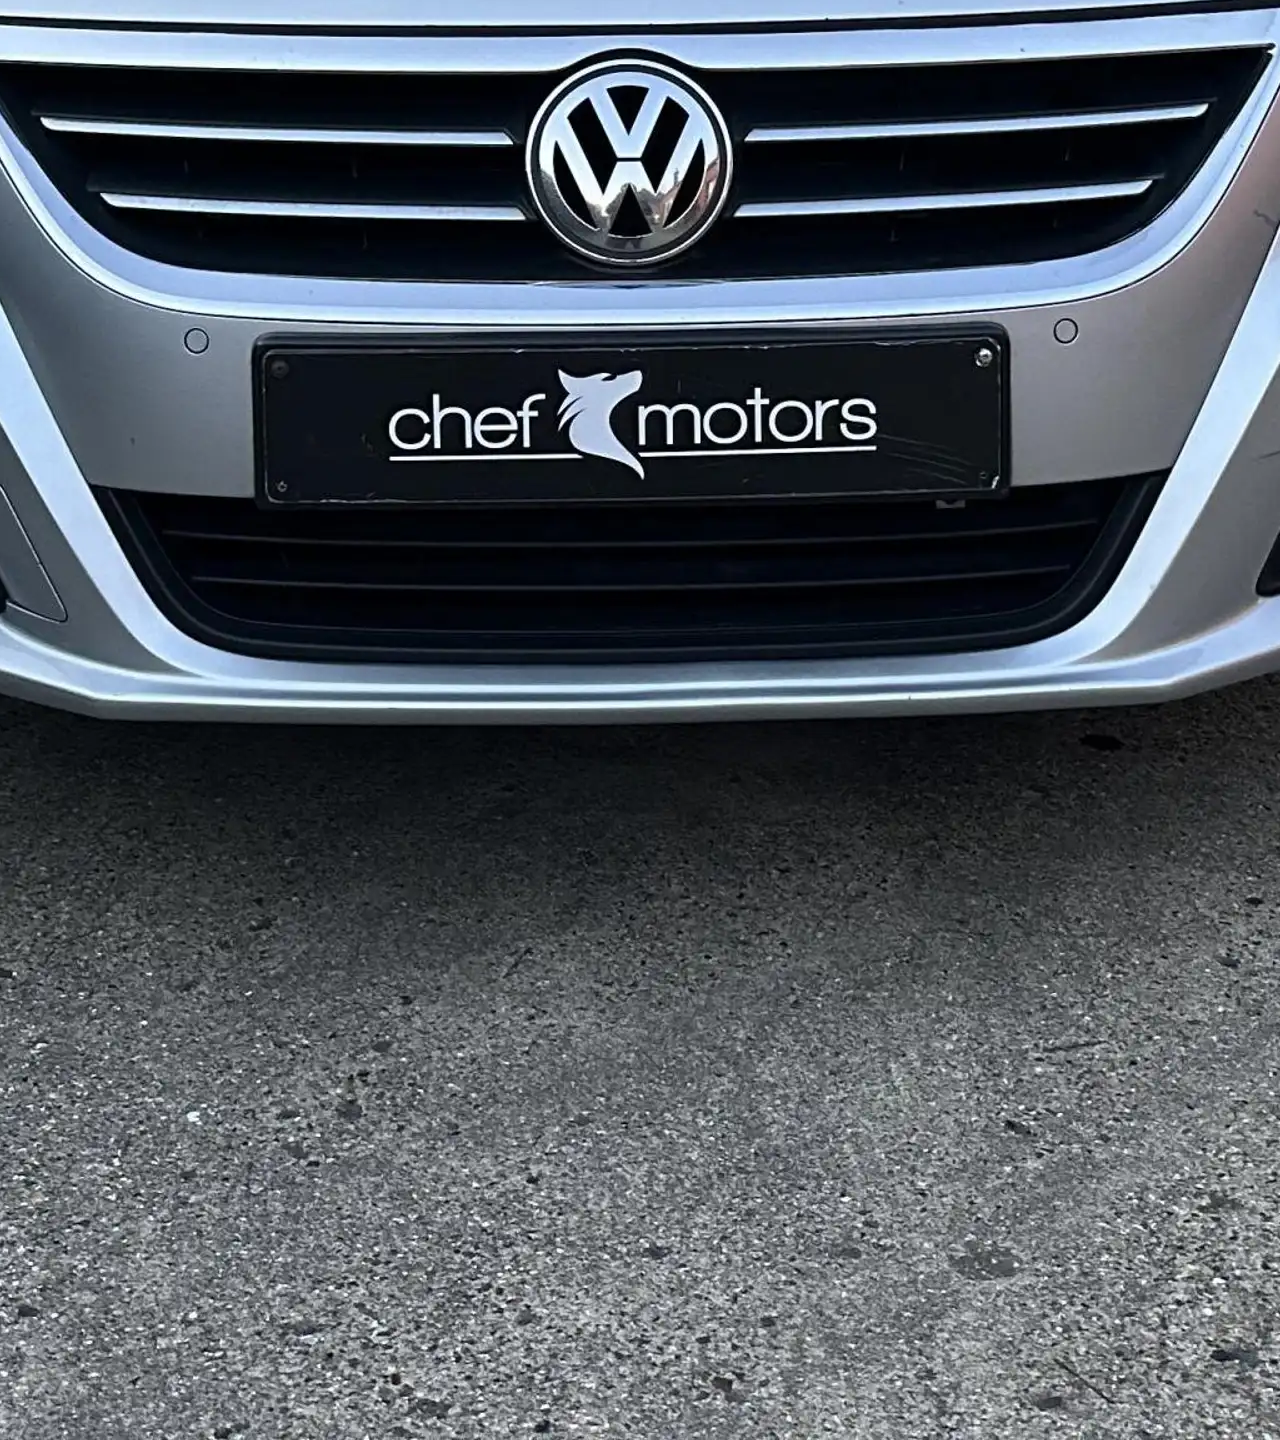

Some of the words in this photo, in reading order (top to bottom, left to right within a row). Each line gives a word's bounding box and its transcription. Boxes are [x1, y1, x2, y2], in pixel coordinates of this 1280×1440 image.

[537, 68, 720, 253] VW
[388, 393, 545, 449] chef
[638, 387, 878, 446] motors
